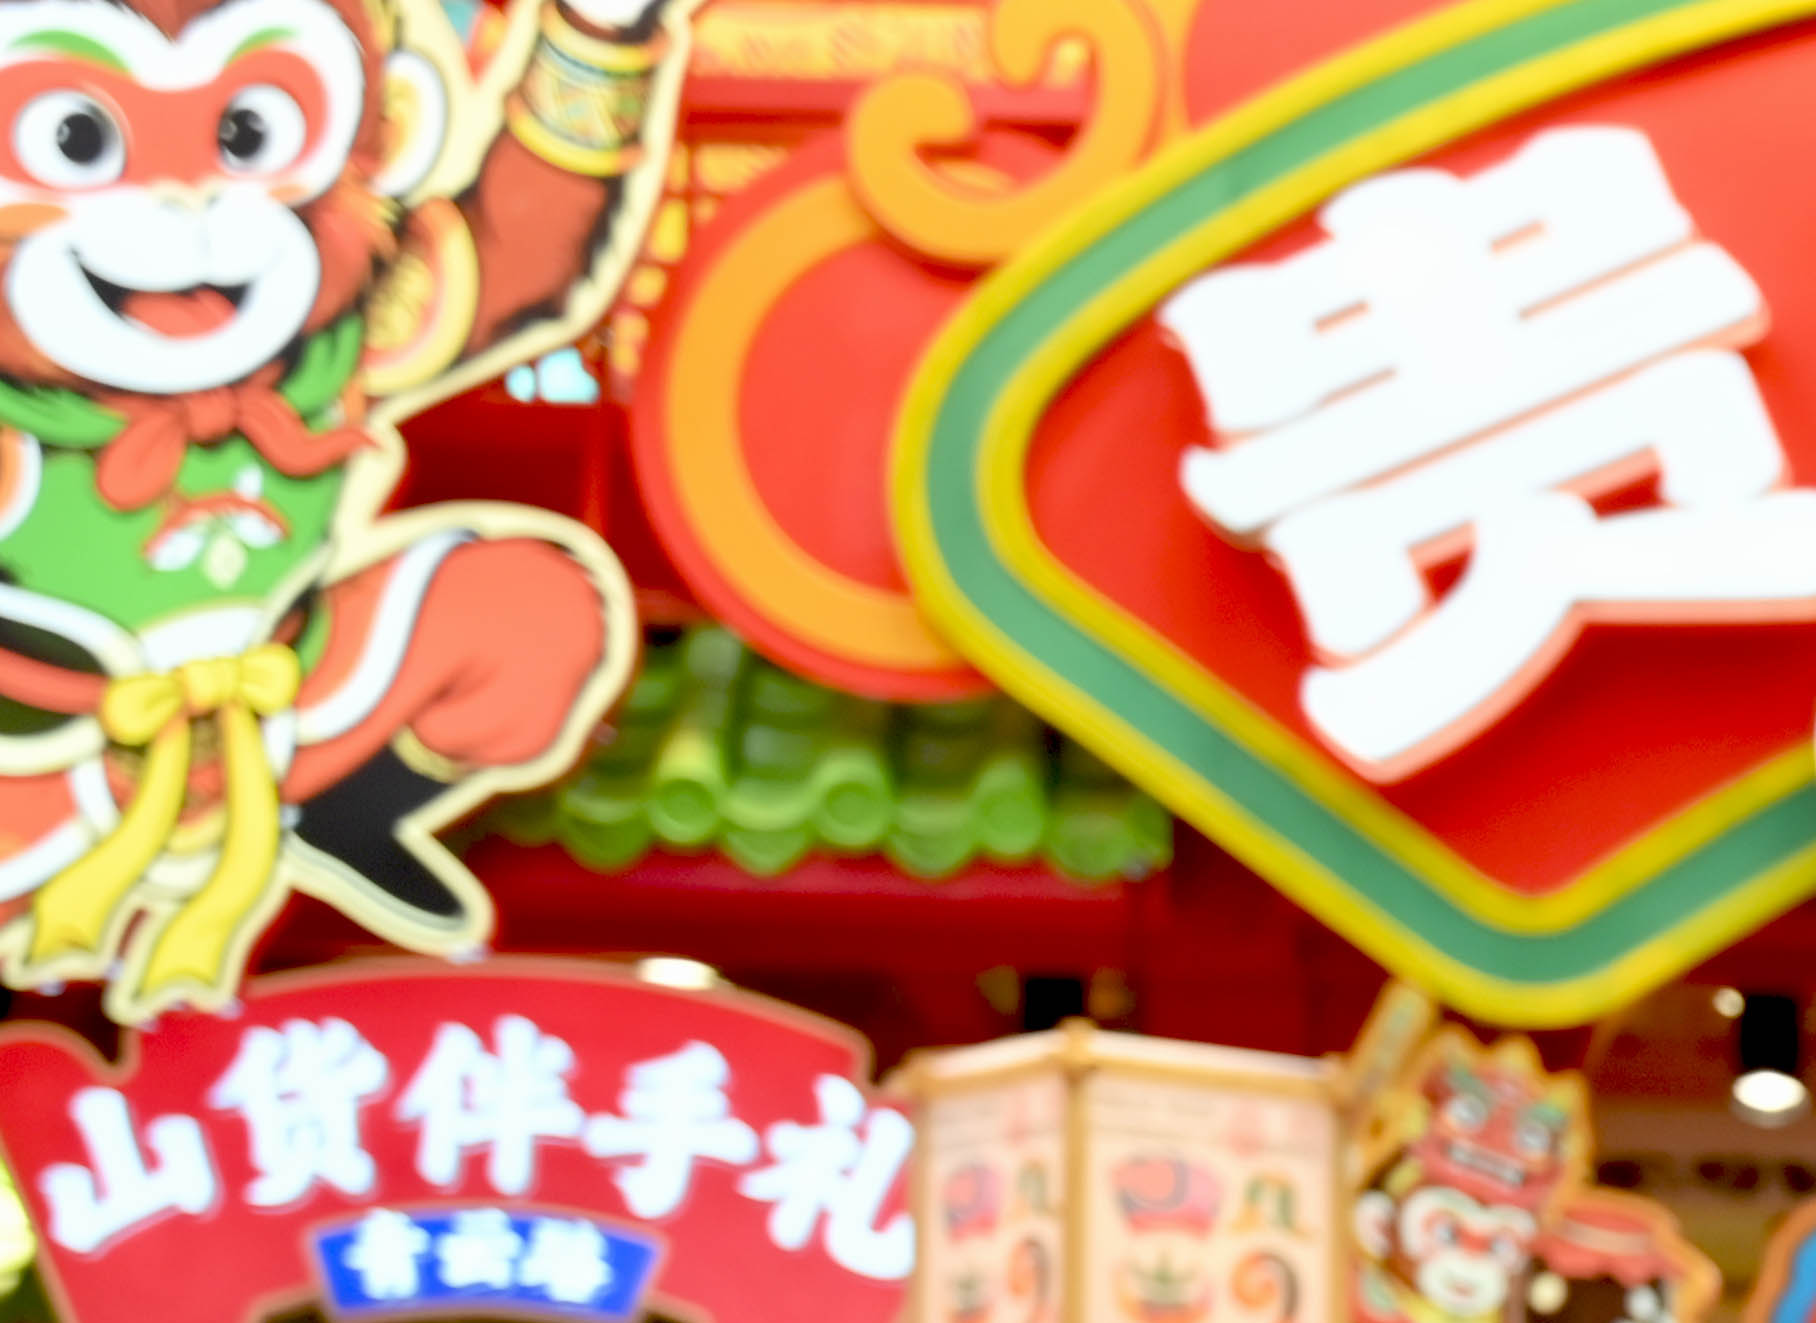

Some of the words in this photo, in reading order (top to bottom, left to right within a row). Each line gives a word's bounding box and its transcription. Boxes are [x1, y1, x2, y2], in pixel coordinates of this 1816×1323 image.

[40, 1015, 915, 1280] 山货伴手礼
